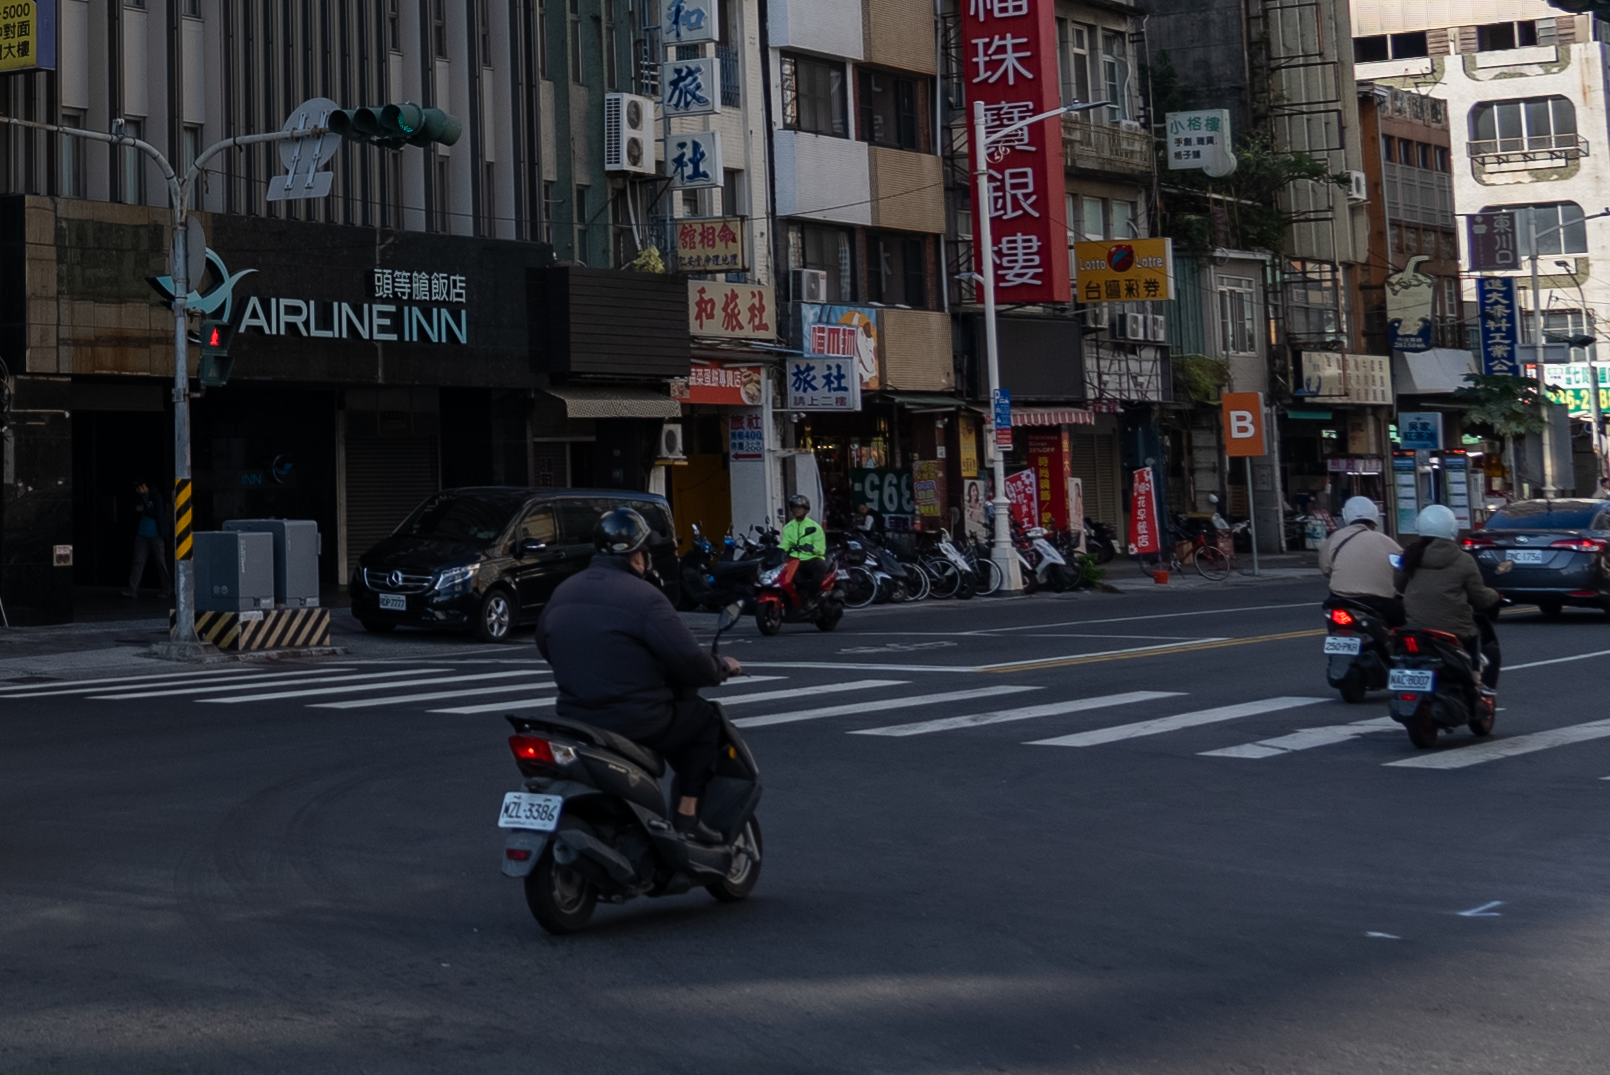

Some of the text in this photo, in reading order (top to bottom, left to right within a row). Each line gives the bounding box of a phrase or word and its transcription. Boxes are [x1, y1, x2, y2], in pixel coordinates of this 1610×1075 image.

[1170, 116, 1221, 135] 小格樓
[1079, 258, 1106, 271] Lotto
[373, 268, 467, 304] 頭等艙飯店
[238, 295, 467, 345] AIRLINE INN
[694, 286, 769, 333] 和旅社
[791, 362, 849, 393] 旅社
[730, 414, 761, 430] 旅社
[1229, 410, 1255, 439] B
[241, 474, 262, 485] INN
